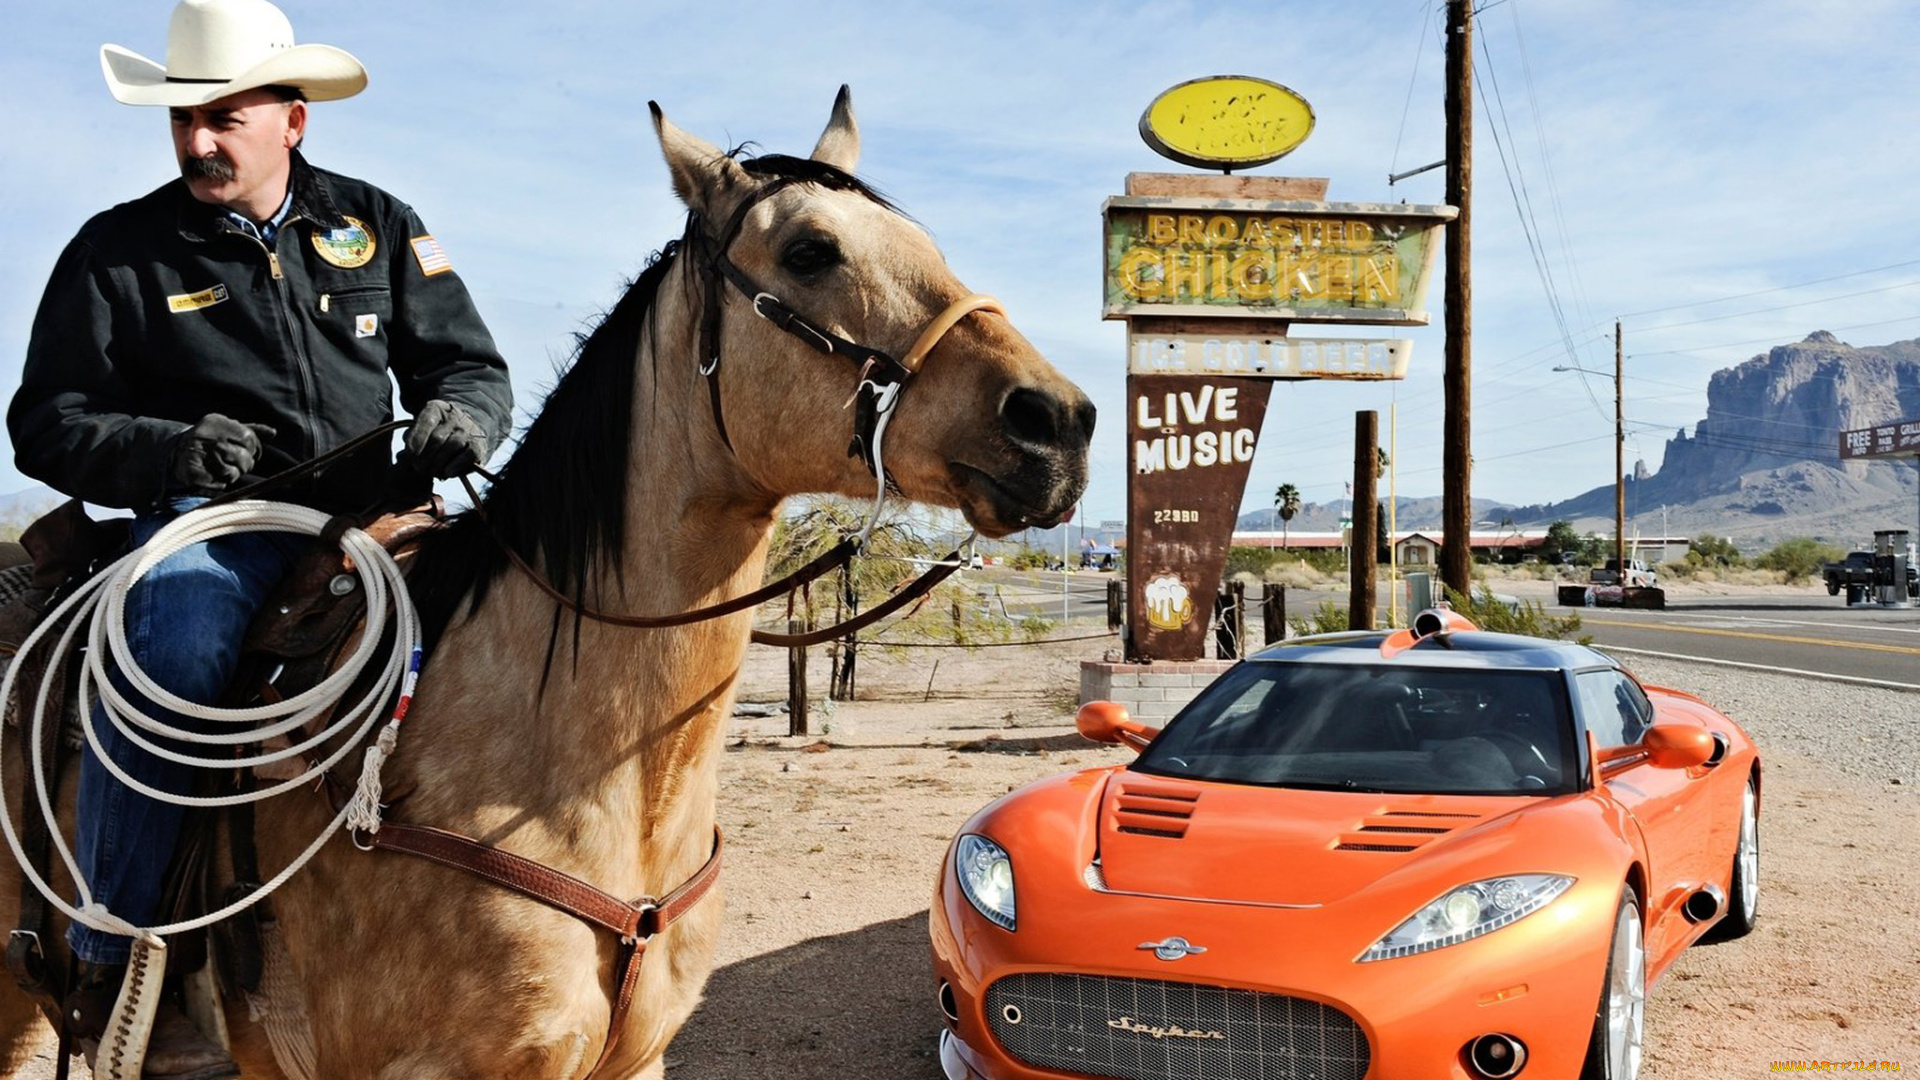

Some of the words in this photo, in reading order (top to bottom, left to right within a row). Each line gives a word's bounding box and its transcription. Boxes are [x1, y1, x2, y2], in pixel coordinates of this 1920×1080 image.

[1147, 214, 1374, 248] BROASTED
[1118, 246, 1401, 302] CHICKEN
[1137, 338, 1187, 370] ICE
[1203, 339, 1290, 371] COLD
[1300, 340, 1390, 372] BEER
[1137, 385, 1239, 429] LIVE
[1135, 428, 1256, 475] MUSIC
[1847, 431, 1871, 448] FREE
[1106, 1016, 1228, 1039] Spyker
